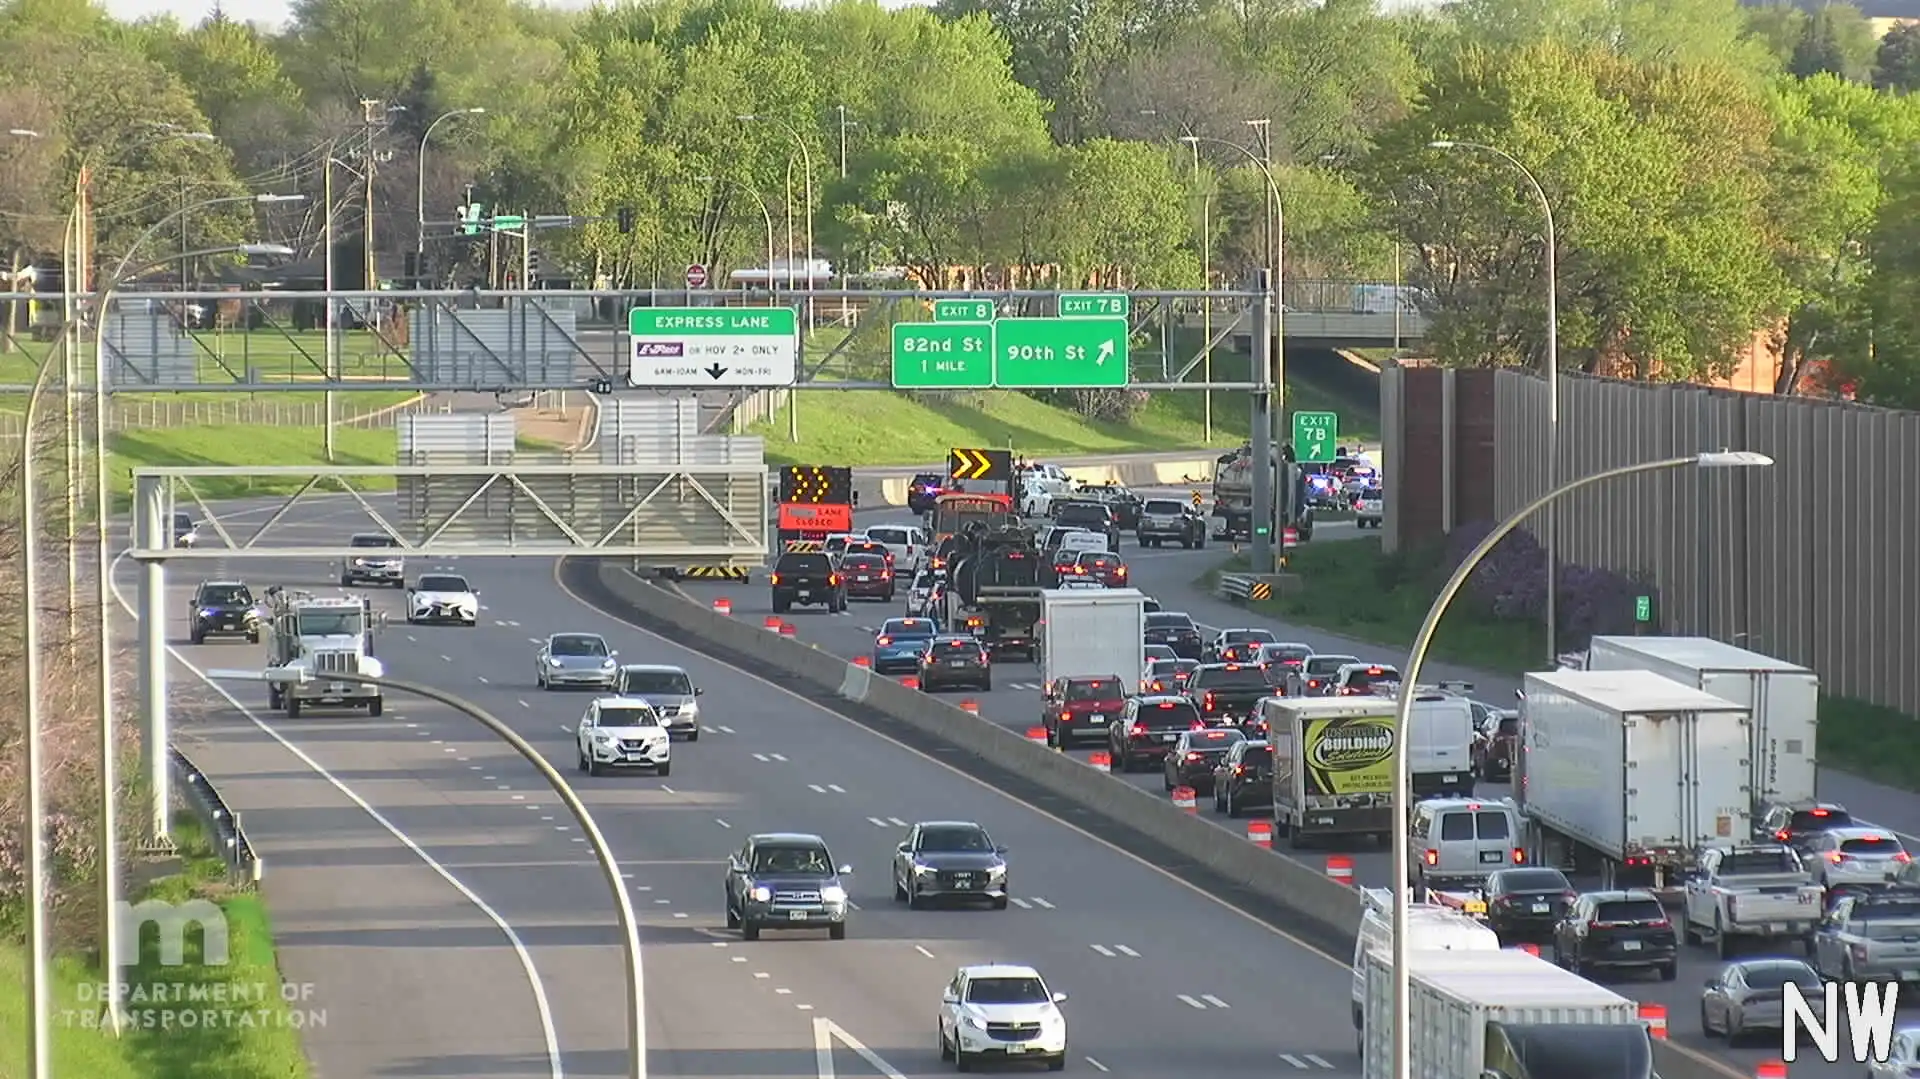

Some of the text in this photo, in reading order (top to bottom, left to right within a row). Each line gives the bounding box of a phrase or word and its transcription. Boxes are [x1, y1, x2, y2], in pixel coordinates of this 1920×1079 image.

[942, 305, 987, 318] EXIT 8
[1065, 299, 1122, 313] EXIT 7B
[655, 316, 769, 328] EXPRESS LANE
[705, 345, 726, 355] HOV
[752, 345, 779, 355] ONLY
[903, 337, 983, 353] 82nd St
[1007, 345, 1086, 361] 90th St
[920, 360, 965, 373] 1 MILE
[1300, 415, 1331, 426] EXIT
[1303, 427, 1326, 441] 7B
[1639, 606, 1647, 617] 7
[1323, 736, 1389, 752] BUILDING
